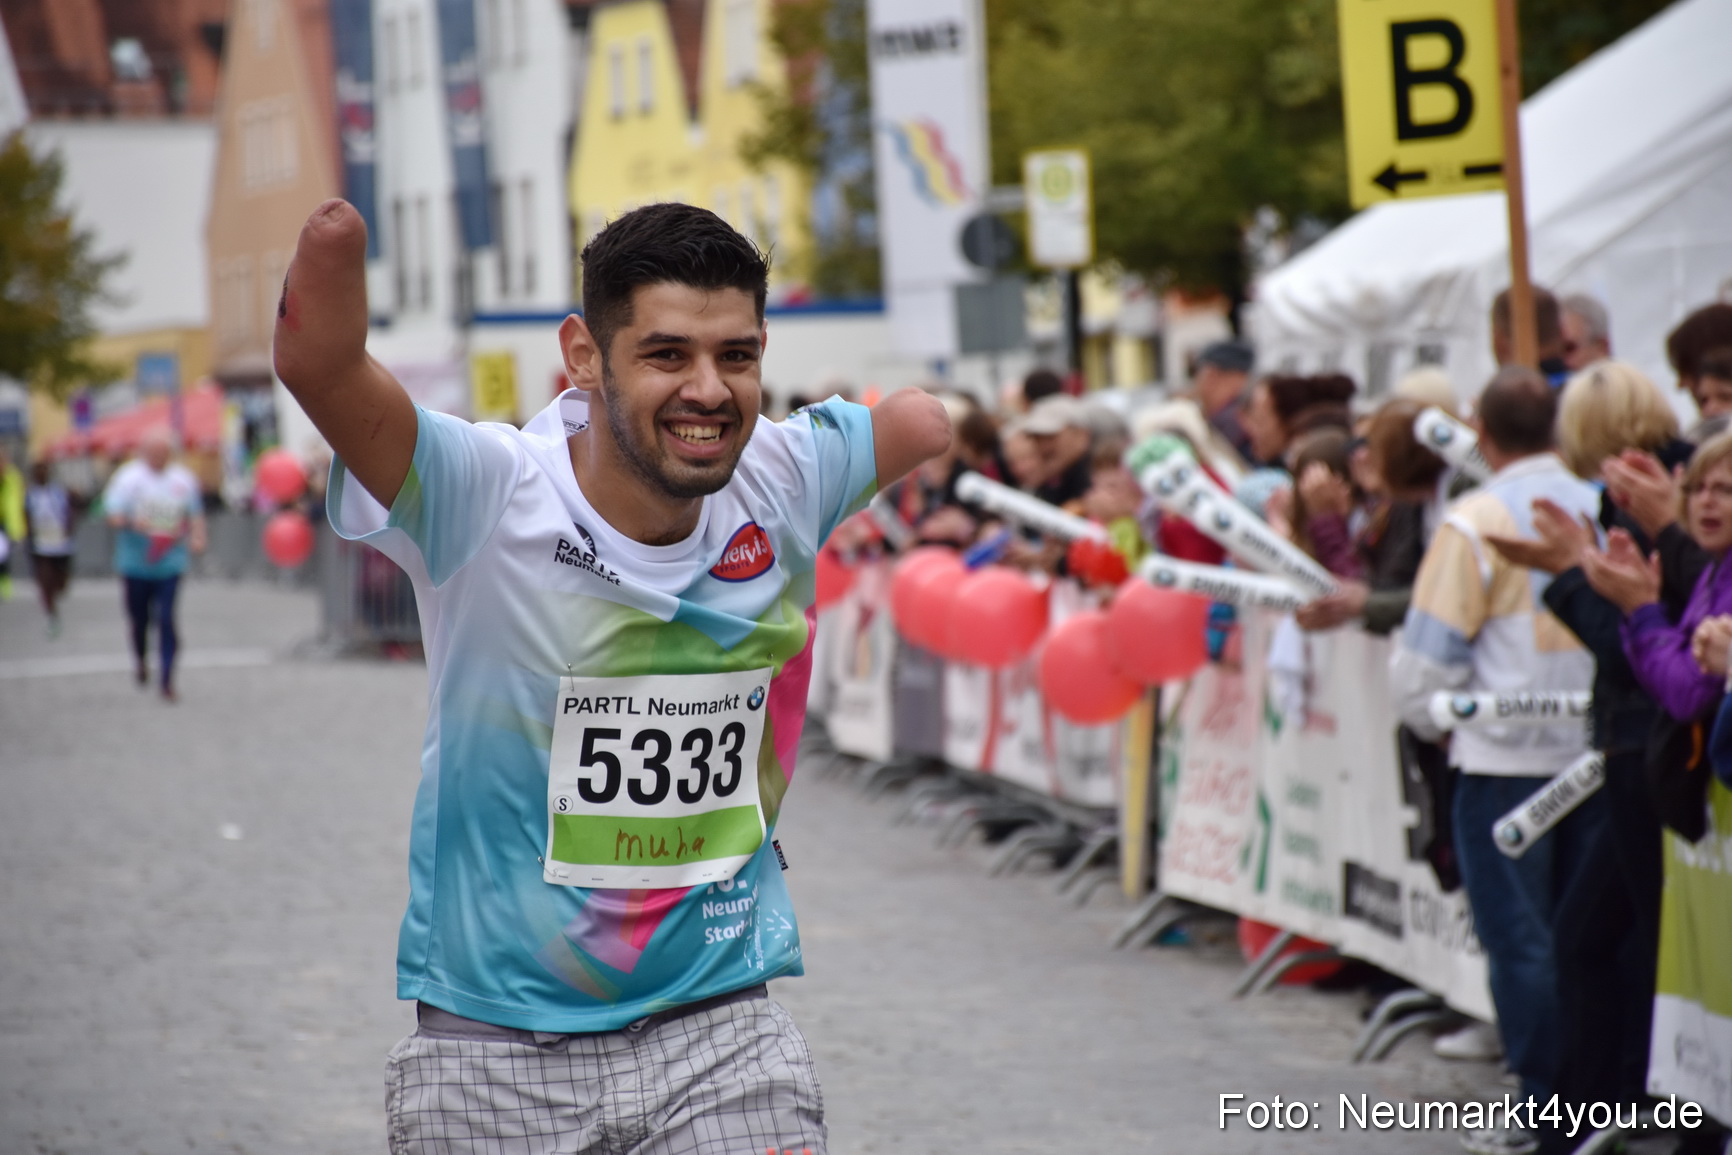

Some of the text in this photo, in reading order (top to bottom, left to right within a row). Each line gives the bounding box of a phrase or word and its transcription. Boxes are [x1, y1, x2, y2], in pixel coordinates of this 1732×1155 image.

[1389, 18, 1475, 141] B
[553, 551, 621, 587] Neumarkt
[556, 537, 619, 577] PAR
[563, 693, 741, 716] PARTL Neumarkt
[577, 721, 746, 805] 5333
[558, 797, 568, 812] S
